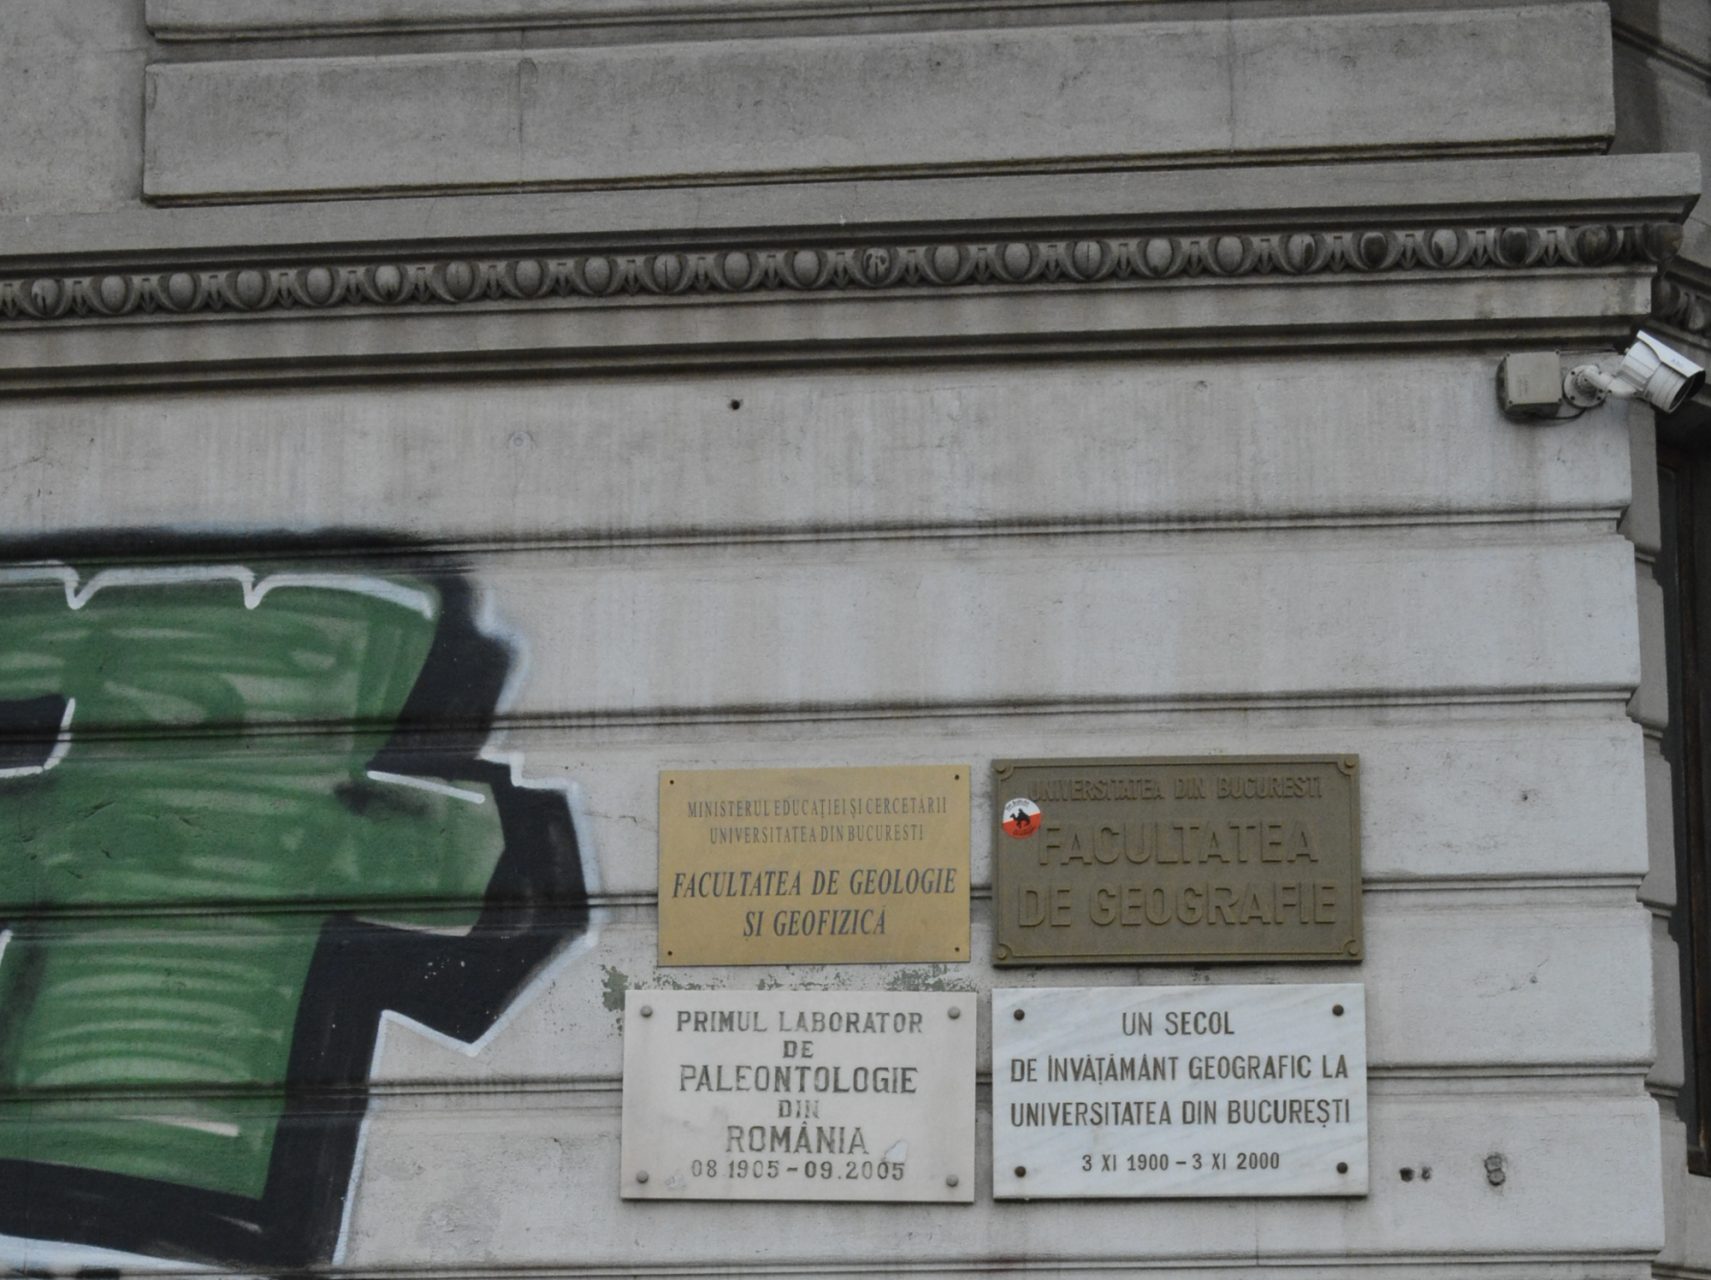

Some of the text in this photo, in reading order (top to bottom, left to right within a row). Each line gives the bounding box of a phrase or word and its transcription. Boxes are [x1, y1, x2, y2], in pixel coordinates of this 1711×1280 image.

[1026, 778, 1164, 801] UNIVERSITATEA
[1174, 777, 1204, 800] DIN
[688, 799, 770, 818] MINISTERUL
[709, 825, 817, 844] UNIVERSITATEA
[820, 825, 844, 842] DIN
[1038, 822, 1320, 867] FACULTATEA
[671, 867, 958, 898] FACULTATEA DE GEOLOGIE
[1017, 881, 1337, 928] DE GEOGRAFIE
[676, 1010, 924, 1034] PRIMUL LABORATOR
[1122, 1010, 1236, 1036] UN SECOL
[782, 1040, 815, 1059] DE
[679, 1064, 919, 1095] PALEONTOLOGIE
[1010, 1058, 1038, 1083] DE
[1188, 1054, 1312, 1080] GEOGRAFIC
[1321, 1053, 1349, 1079] LA
[777, 1099, 820, 1119] DIN
[1010, 1100, 1172, 1127] UNIVERSITATEA
[1181, 1099, 1218, 1125] DIN
[725, 1121, 870, 1156] ROMÂNIA
[1081, 1153, 1093, 1172] 3
[1101, 1153, 1118, 1171] XI
[1127, 1153, 1170, 1171] 1900
[1192, 1152, 1203, 1170] 3
[1211, 1152, 1228, 1170] XI
[1236, 1151, 1281, 1170] 2000
